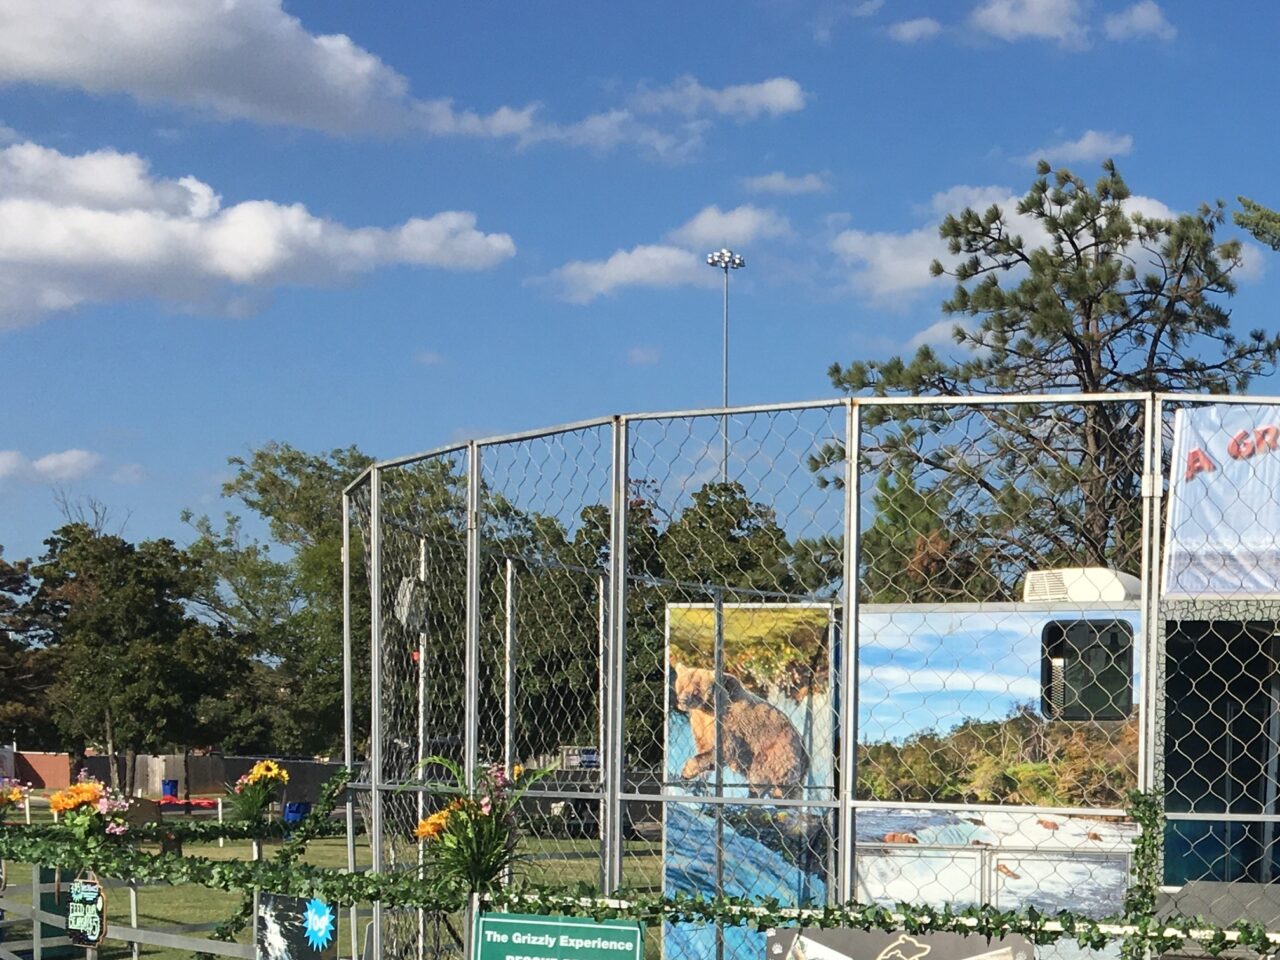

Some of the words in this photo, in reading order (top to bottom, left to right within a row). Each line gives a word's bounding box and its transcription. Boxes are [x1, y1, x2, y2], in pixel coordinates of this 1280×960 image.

[1184, 448, 1217, 482] A
[485, 931, 508, 943] The
[512, 932, 556, 948] Grizzly
[560, 935, 633, 951] Experience
